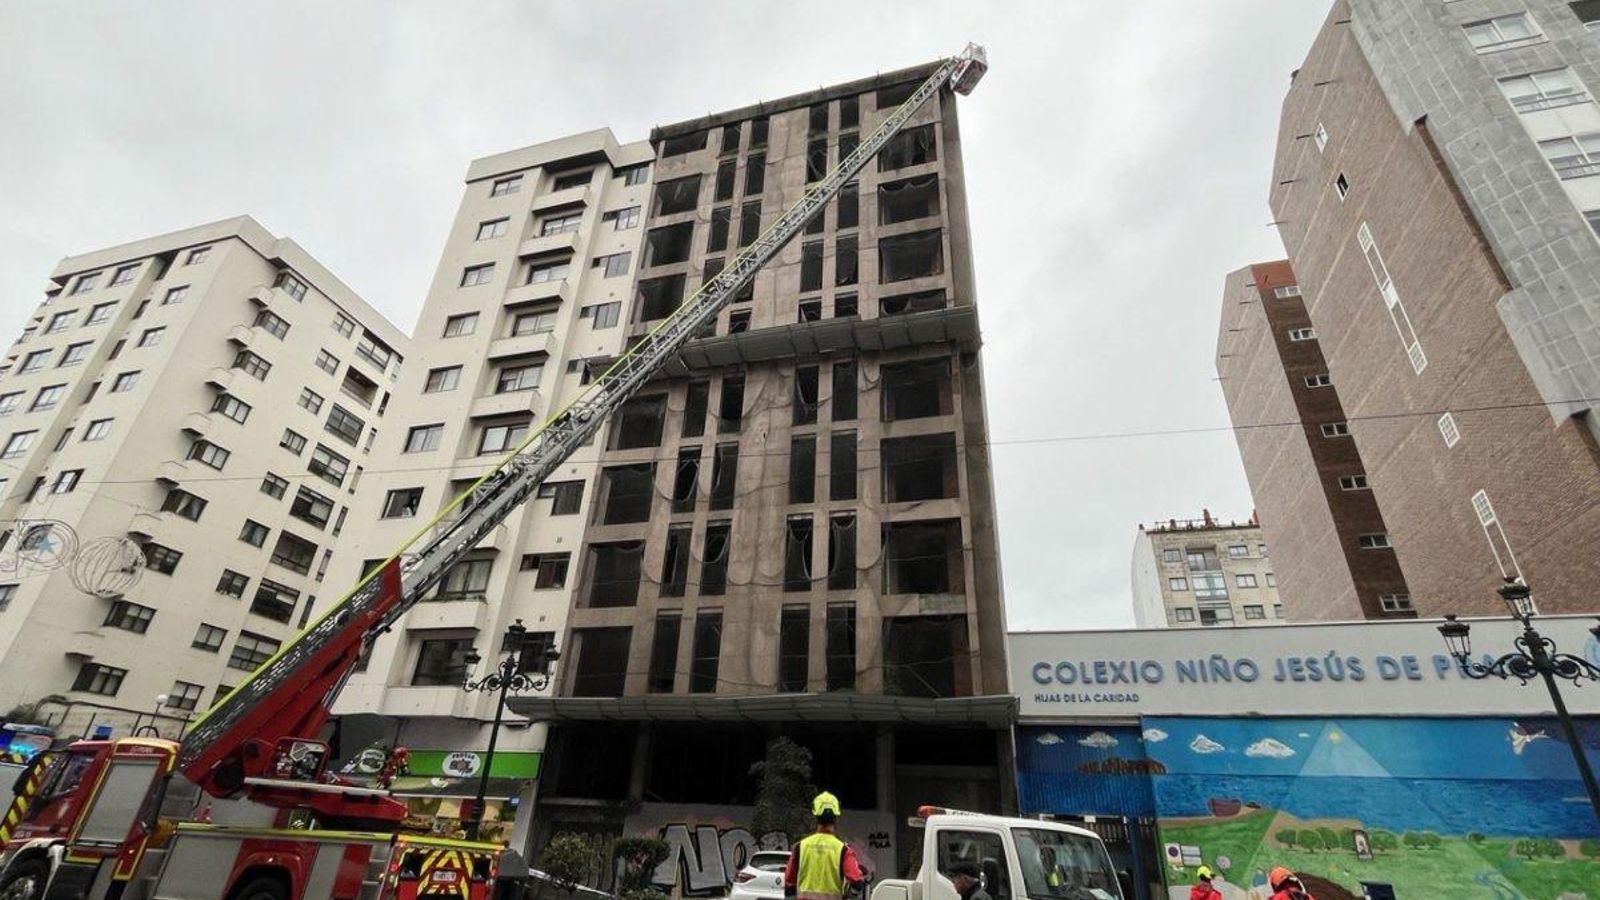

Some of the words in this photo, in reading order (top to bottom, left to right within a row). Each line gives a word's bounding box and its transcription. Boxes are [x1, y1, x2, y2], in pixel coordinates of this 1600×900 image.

[1032, 661, 1164, 685] COLEXIO
[1175, 654, 1260, 683] NIÑO
[1274, 650, 1366, 682] JESÚS
[1376, 655, 1422, 680] DE
[1034, 693, 1061, 703] HIJAS
[1063, 693, 1077, 703] DE
[1078, 693, 1092, 703] LA
[1093, 693, 1140, 703] CARIDAD
